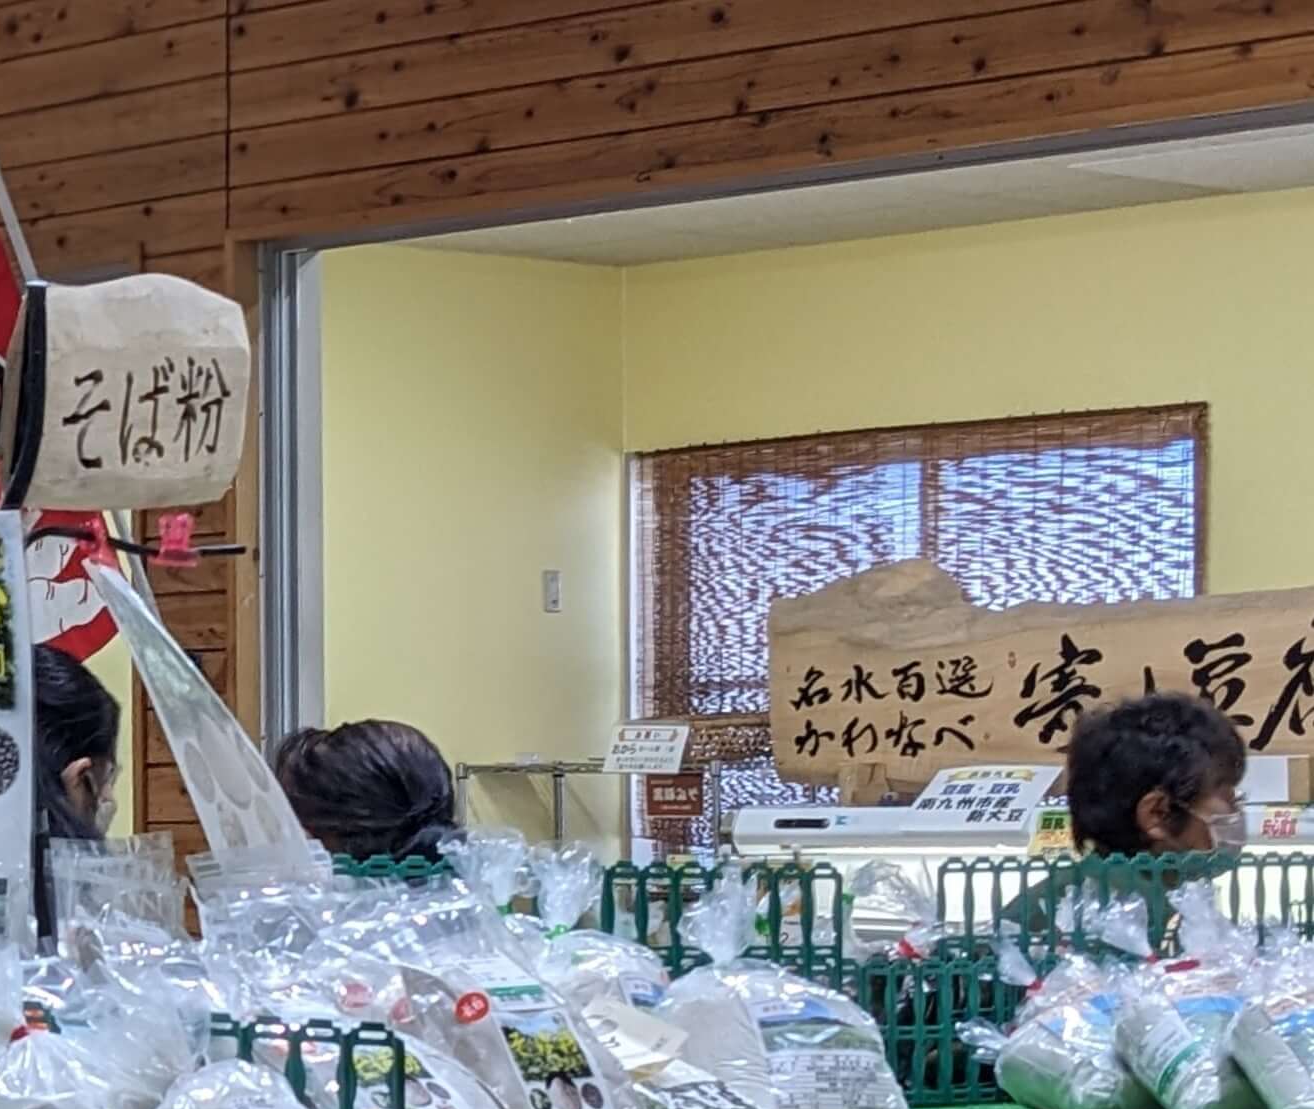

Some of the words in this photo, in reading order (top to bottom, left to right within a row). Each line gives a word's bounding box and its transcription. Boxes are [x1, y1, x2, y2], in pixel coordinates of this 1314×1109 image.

[62, 355, 230, 471] そば粉
[791, 654, 993, 711] 名水百選
[794, 711, 976, 758] かわなべ
